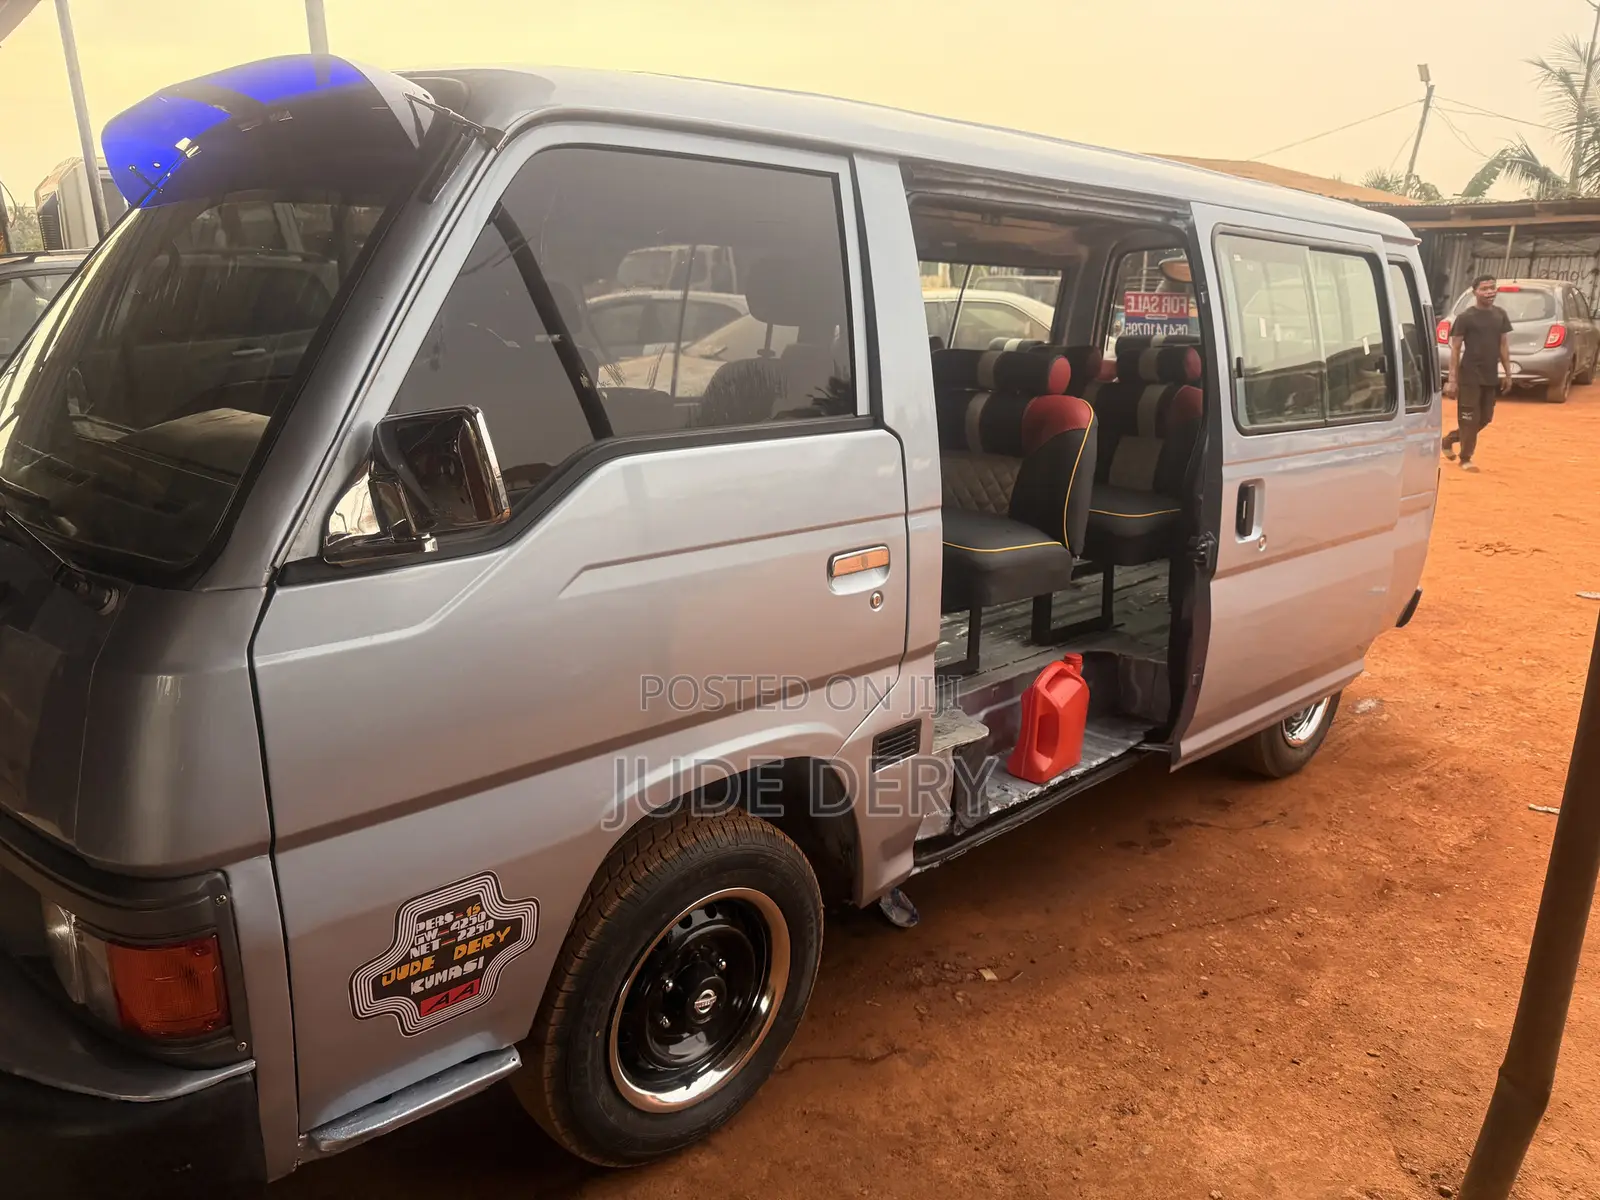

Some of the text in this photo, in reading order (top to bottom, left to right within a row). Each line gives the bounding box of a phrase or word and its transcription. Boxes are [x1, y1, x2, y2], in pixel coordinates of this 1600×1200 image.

[381, 926, 512, 987] JUDE DERY
[410, 955, 485, 996] KUMASI
